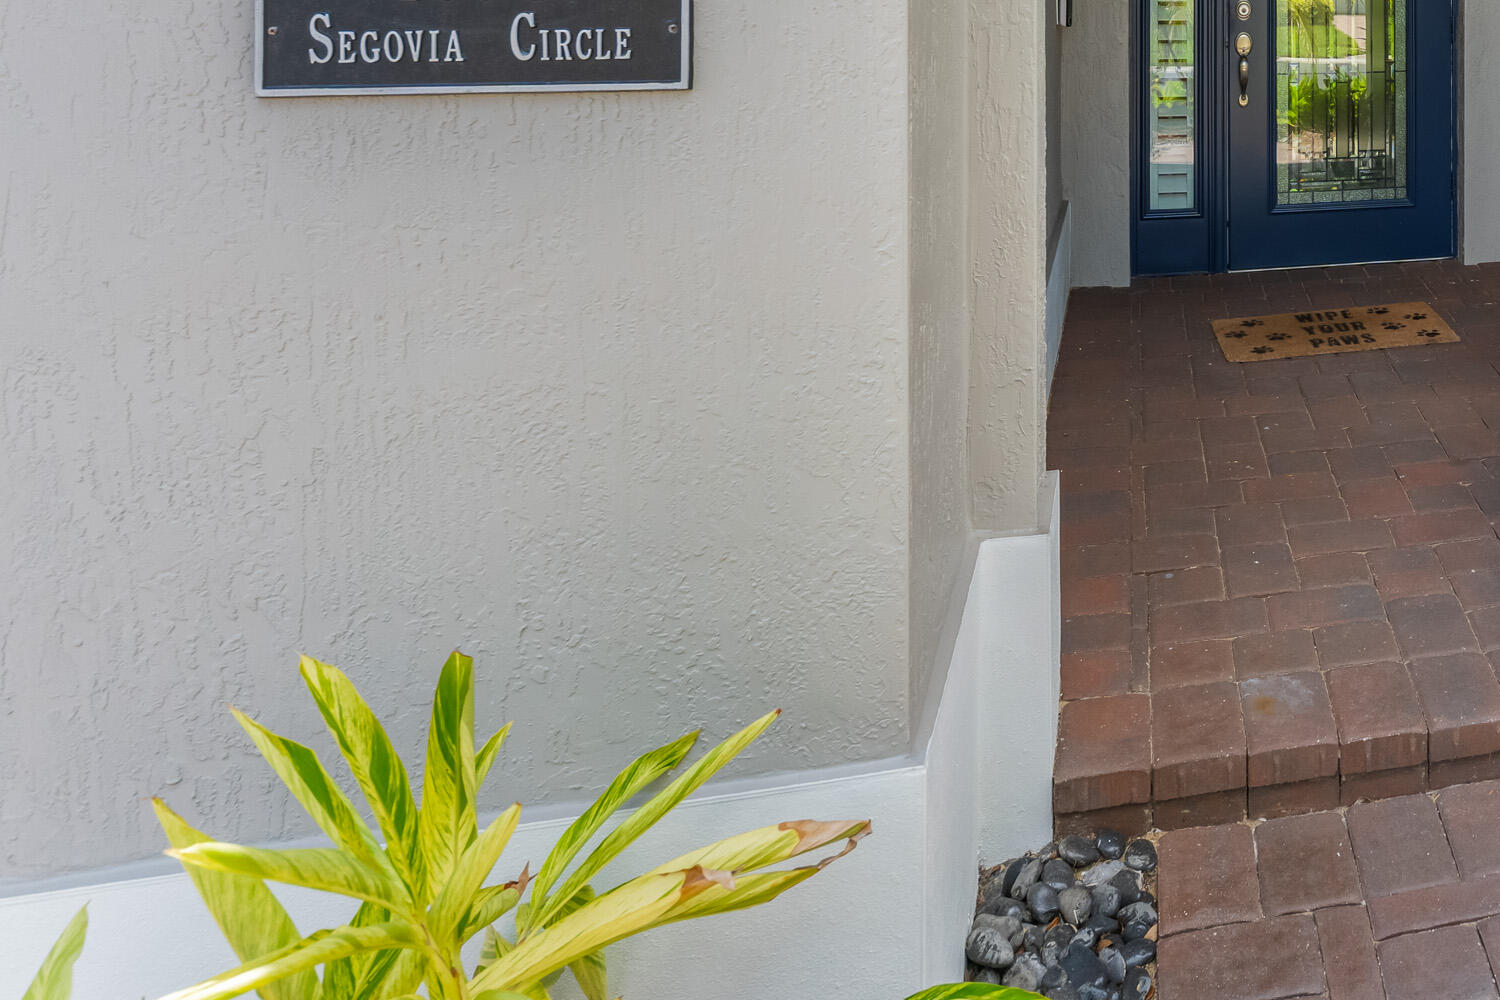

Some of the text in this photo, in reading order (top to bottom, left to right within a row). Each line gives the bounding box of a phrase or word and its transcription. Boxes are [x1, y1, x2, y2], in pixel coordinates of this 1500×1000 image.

[308, 11, 633, 64] SEGOVIA CIRCLE
[1294, 309, 1353, 323] WIPE
[1301, 321, 1367, 335] YOUR
[1309, 333, 1377, 348] PAWS
